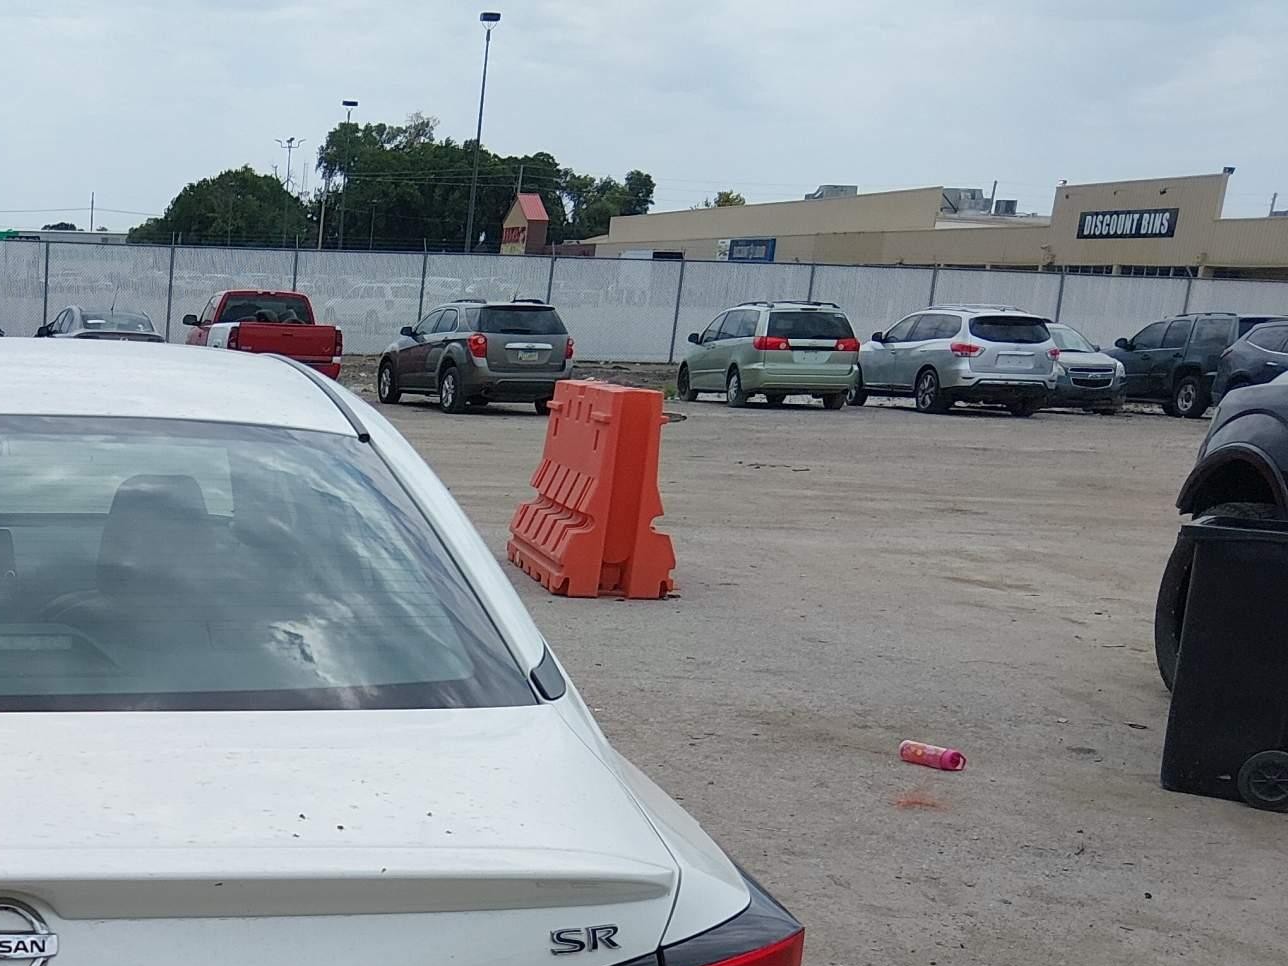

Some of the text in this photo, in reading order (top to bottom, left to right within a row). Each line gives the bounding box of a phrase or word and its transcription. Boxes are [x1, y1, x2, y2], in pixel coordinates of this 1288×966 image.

[1083, 212, 1170, 236] DISCOUNT BINS
[550, 924, 623, 956] SR
